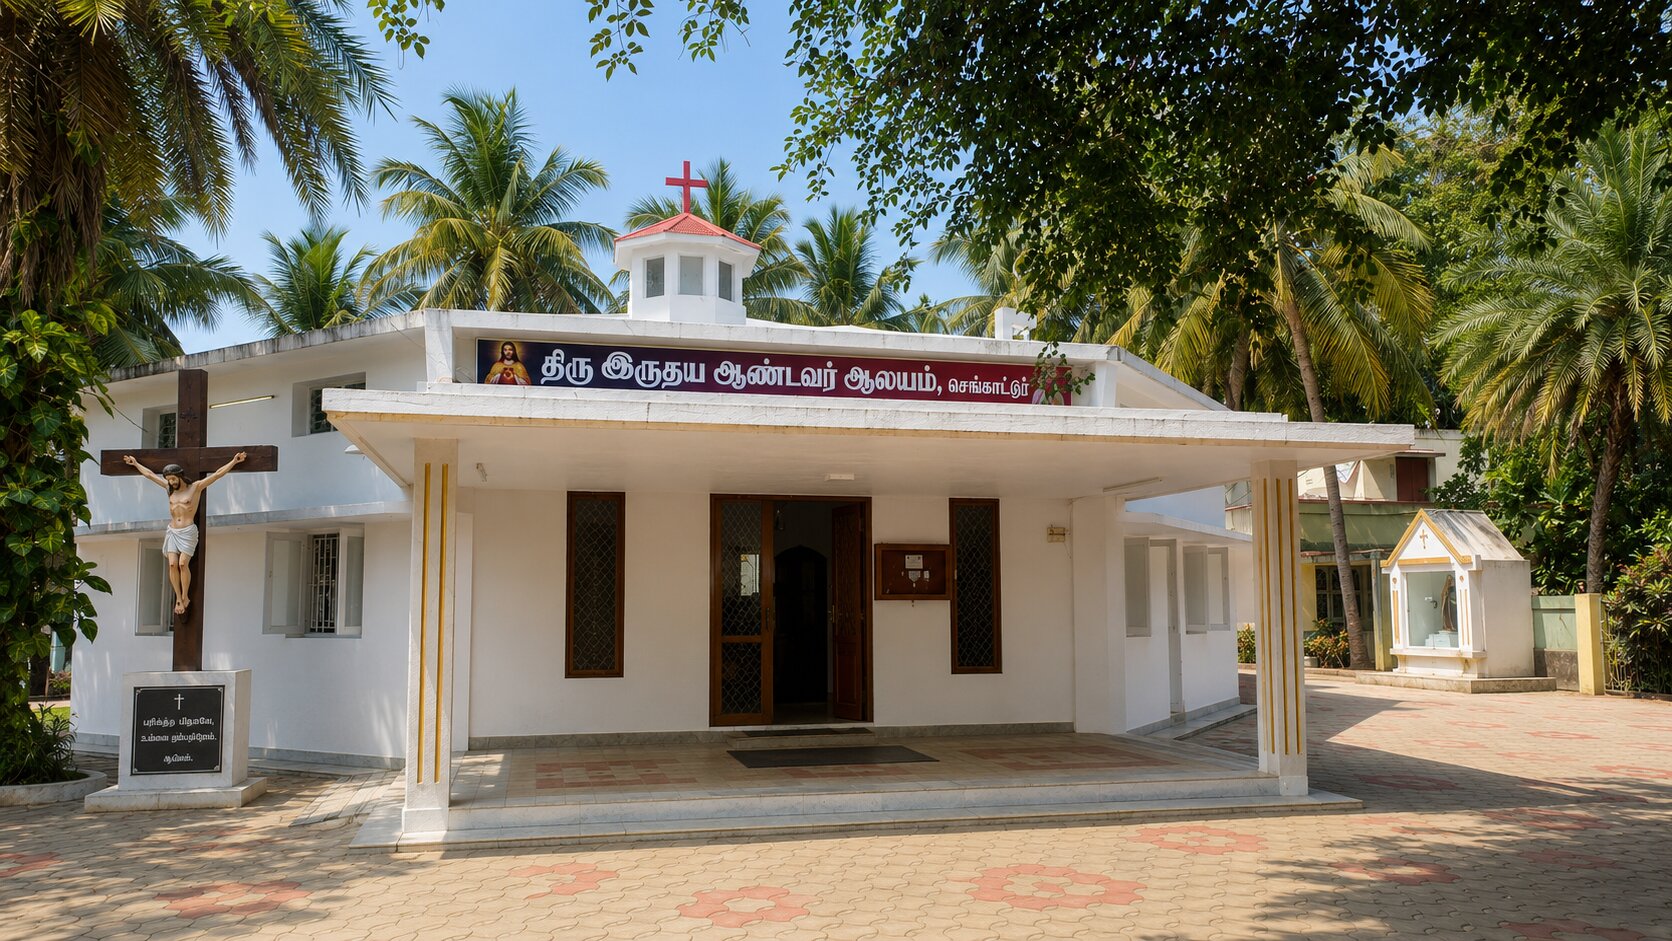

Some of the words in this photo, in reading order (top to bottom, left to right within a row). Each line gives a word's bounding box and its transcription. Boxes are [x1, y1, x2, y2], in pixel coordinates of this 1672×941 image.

[541, 349, 593, 385] திரு
[601, 352, 705, 388] இருதய
[714, 358, 837, 392] ஆண்டவர்
[845, 365, 942, 395] ஆலயம்,
